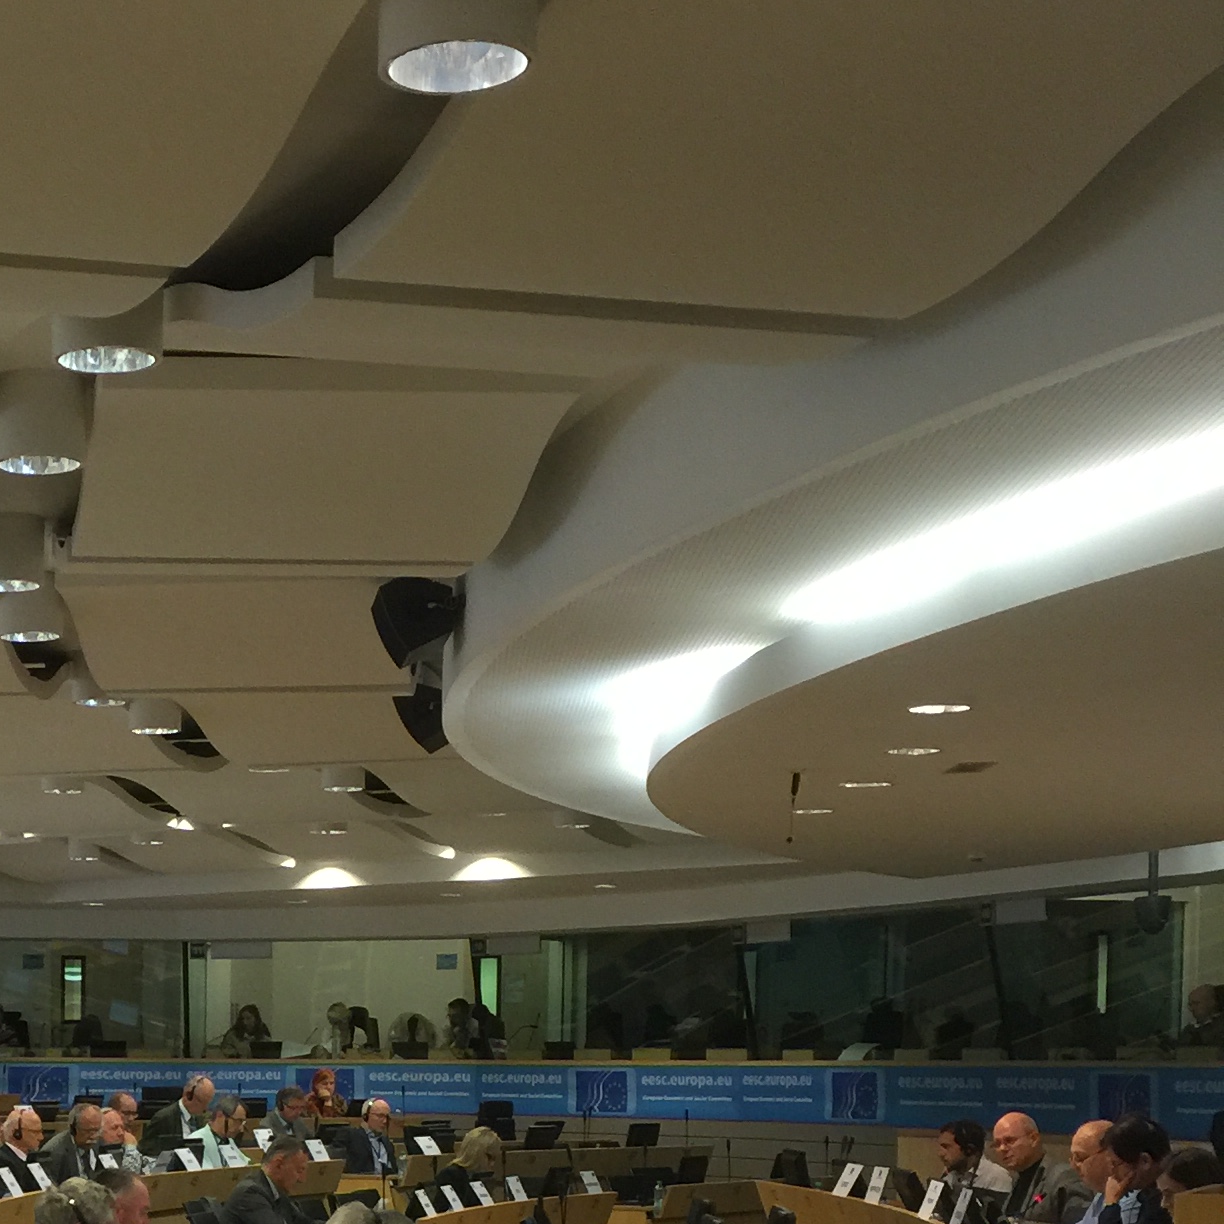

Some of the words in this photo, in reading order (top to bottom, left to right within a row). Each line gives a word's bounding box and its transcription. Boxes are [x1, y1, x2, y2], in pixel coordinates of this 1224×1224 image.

[80, 1070, 182, 1082] eesc.europa.eu
[369, 1071, 471, 1084] eesc.europa.eu
[481, 1073, 562, 1086] eesc.europa.eu
[641, 1075, 733, 1089] eesc.europa.eu
[742, 1074, 813, 1089] eesc.europa.eu
